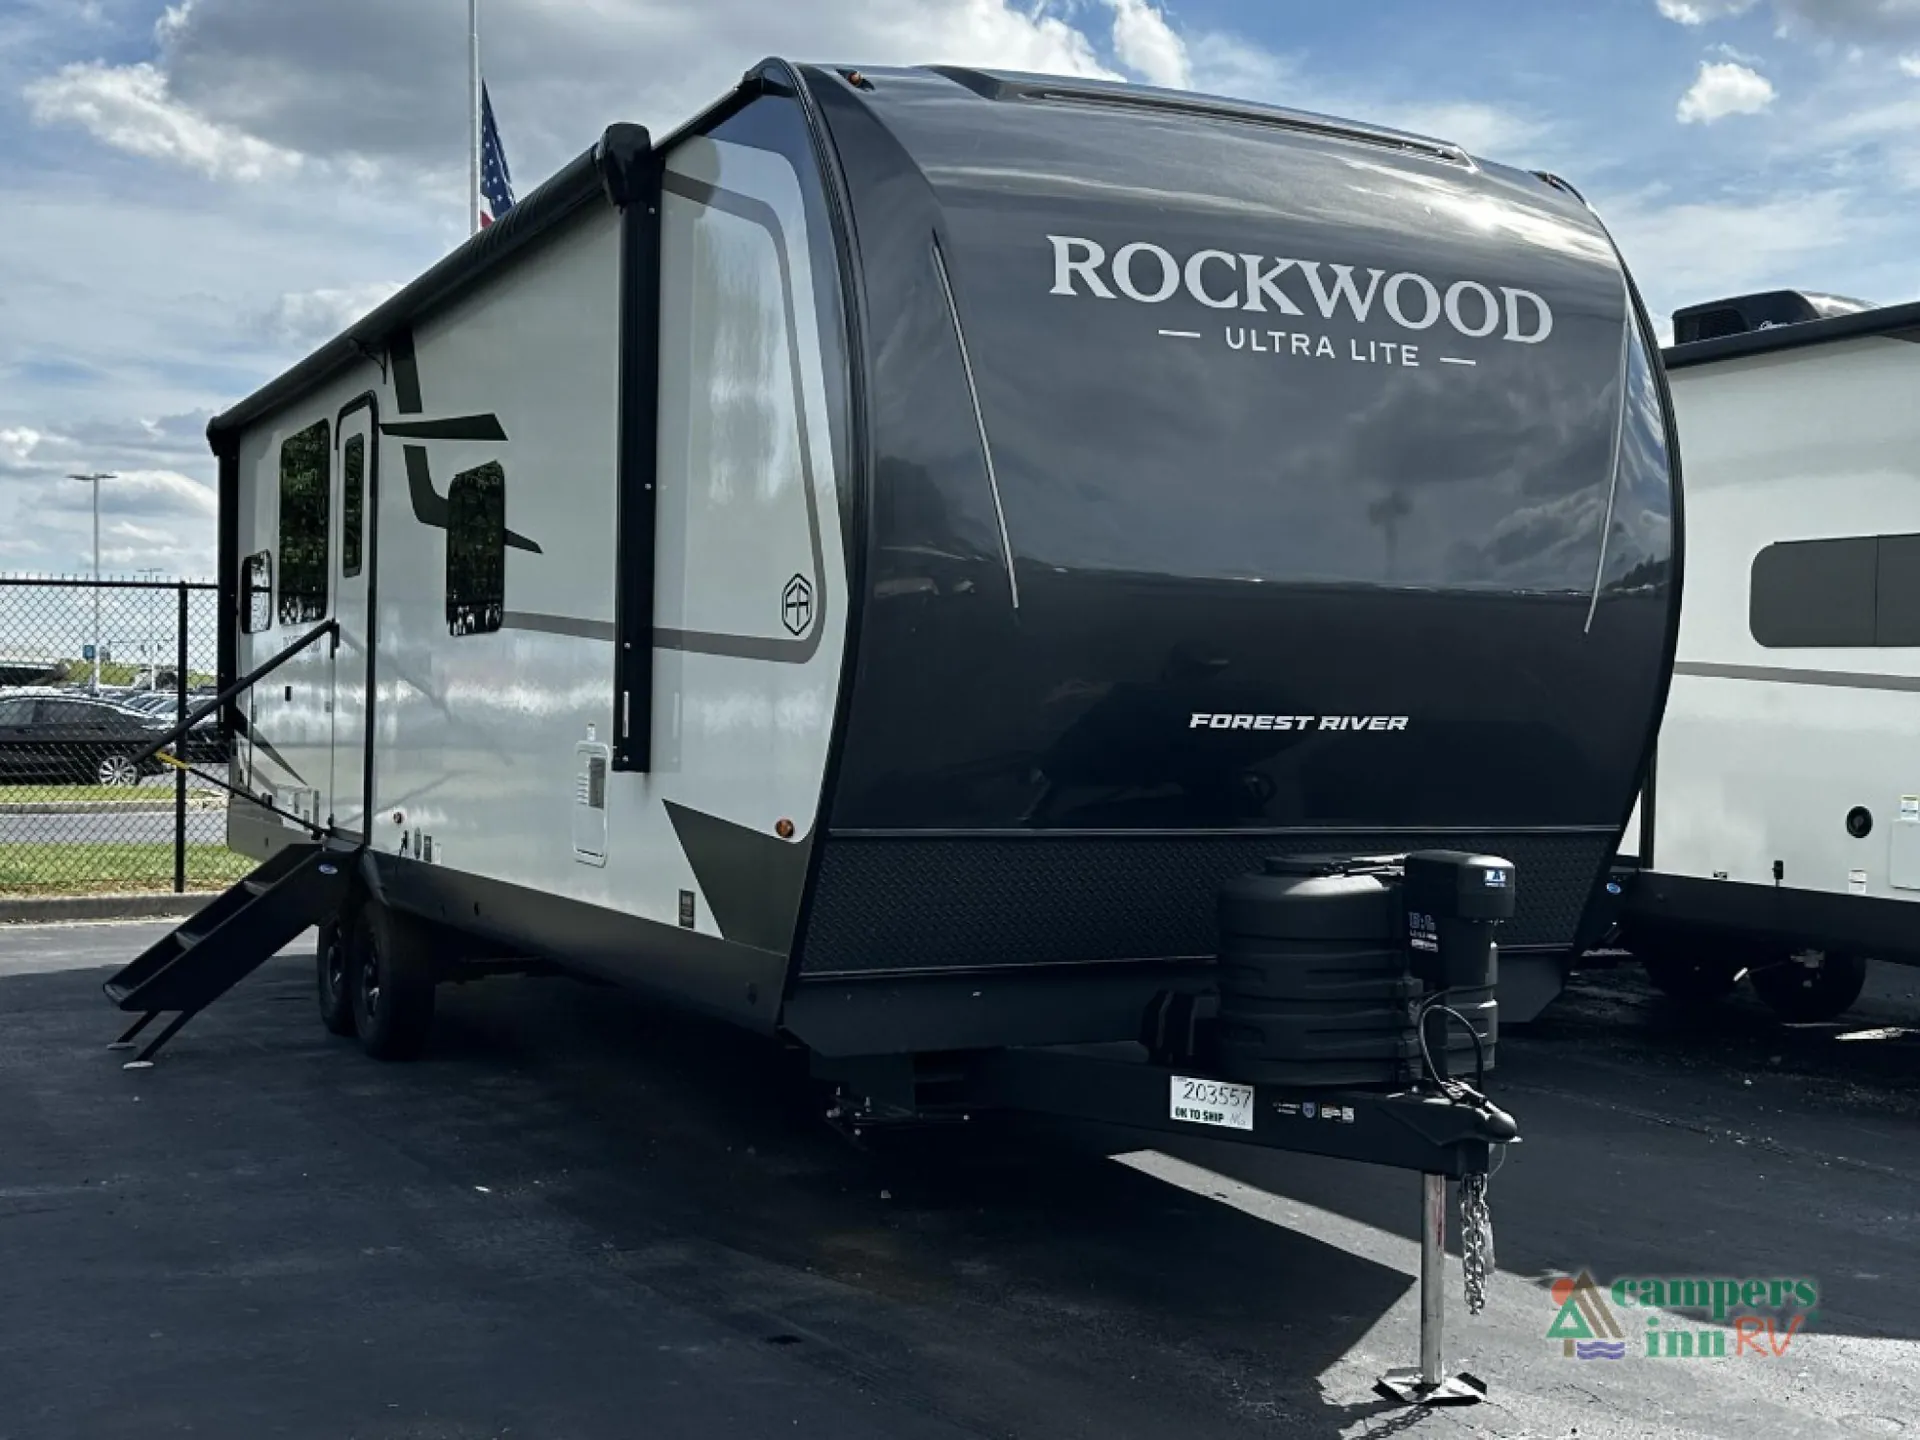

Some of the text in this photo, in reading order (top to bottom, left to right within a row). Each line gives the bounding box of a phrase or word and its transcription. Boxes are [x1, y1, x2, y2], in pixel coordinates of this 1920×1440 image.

[1045, 234, 1554, 344] ROCKWOOD
[1226, 326, 1420, 367] ULTRA LITE
[1188, 713, 1409, 731] FOREST RIVER
[1182, 1081, 1252, 1109] 203557
[1175, 1105, 1188, 1118] OK
[1190, 1108, 1201, 1120] TO
[1203, 1110, 1225, 1123] SHIP
